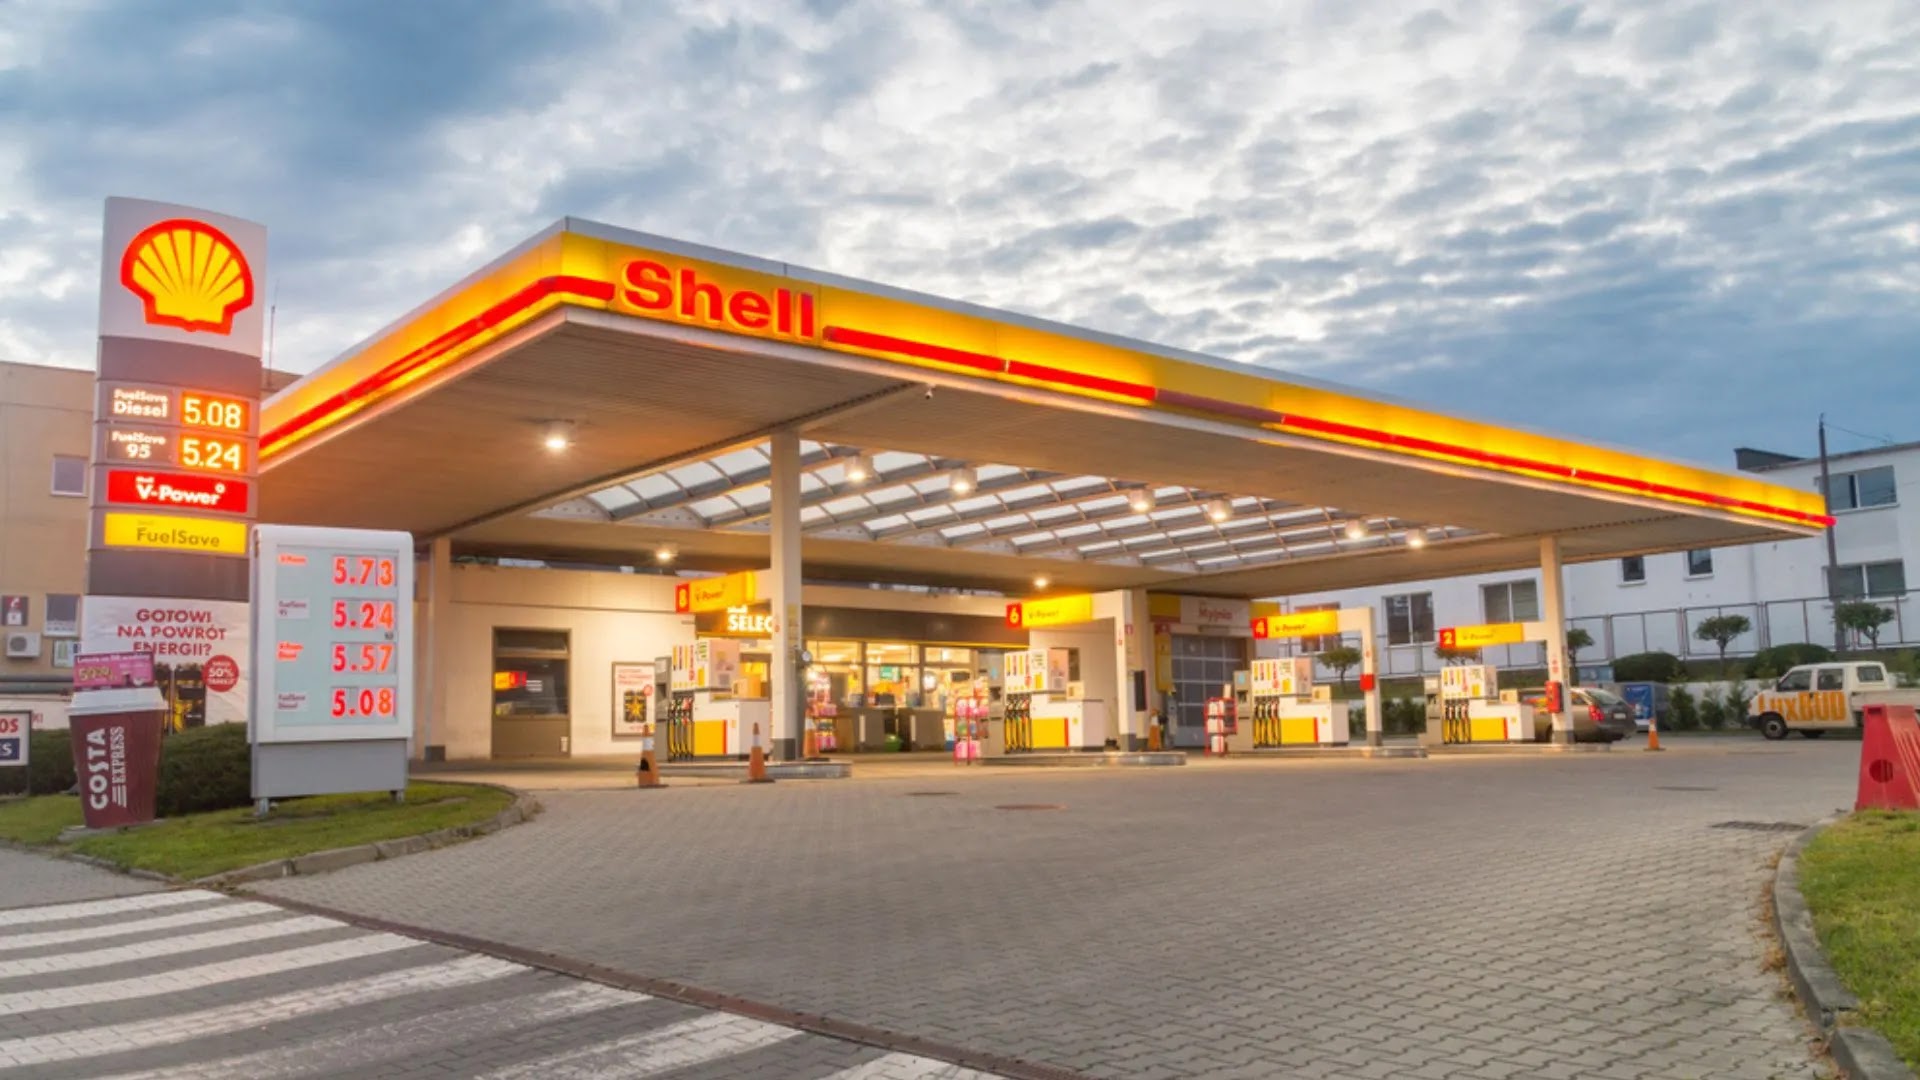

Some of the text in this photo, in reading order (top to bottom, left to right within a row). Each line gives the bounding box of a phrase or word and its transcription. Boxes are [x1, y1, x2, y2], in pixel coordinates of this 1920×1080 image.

[624, 259, 814, 338] Shell
[114, 400, 167, 417] Diesel
[184, 397, 242, 429] 5.08
[112, 431, 166, 445] FuelSave
[126, 444, 151, 459] 95
[182, 438, 242, 471] 5.24
[136, 482, 221, 505] V-Power
[136, 527, 220, 547] FuelSave
[333, 557, 394, 587] 5.73
[136, 608, 212, 623] GOTOWI
[333, 602, 394, 629] 5.24
[728, 614, 773, 632] SELEC
[1010, 607, 1020, 624] 6
[117, 625, 227, 641] NA POWRÓT
[1255, 621, 1265, 635] 4
[1443, 631, 1453, 645] 2
[133, 641, 212, 656] ENERGII?
[332, 644, 394, 673] 5.57
[331, 688, 393, 717] 5.08
[110, 726, 127, 784] EXPRESS
[86, 727, 109, 811] COSTA
